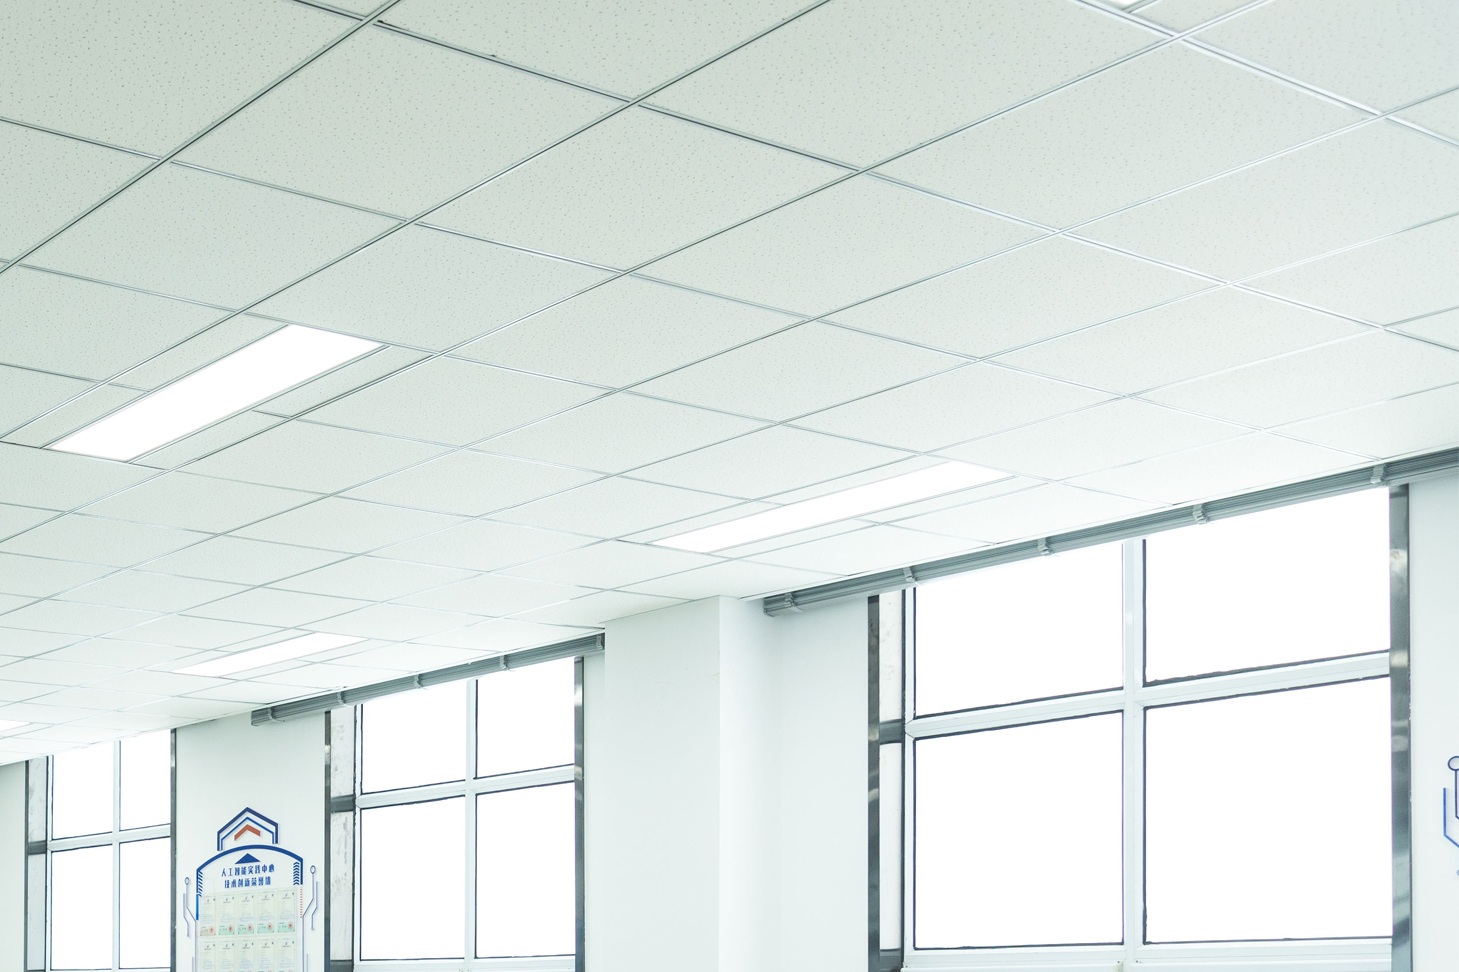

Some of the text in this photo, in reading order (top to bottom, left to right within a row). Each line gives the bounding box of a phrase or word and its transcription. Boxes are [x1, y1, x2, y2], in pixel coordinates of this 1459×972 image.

[221, 863, 275, 877] 人工智能实践中心
